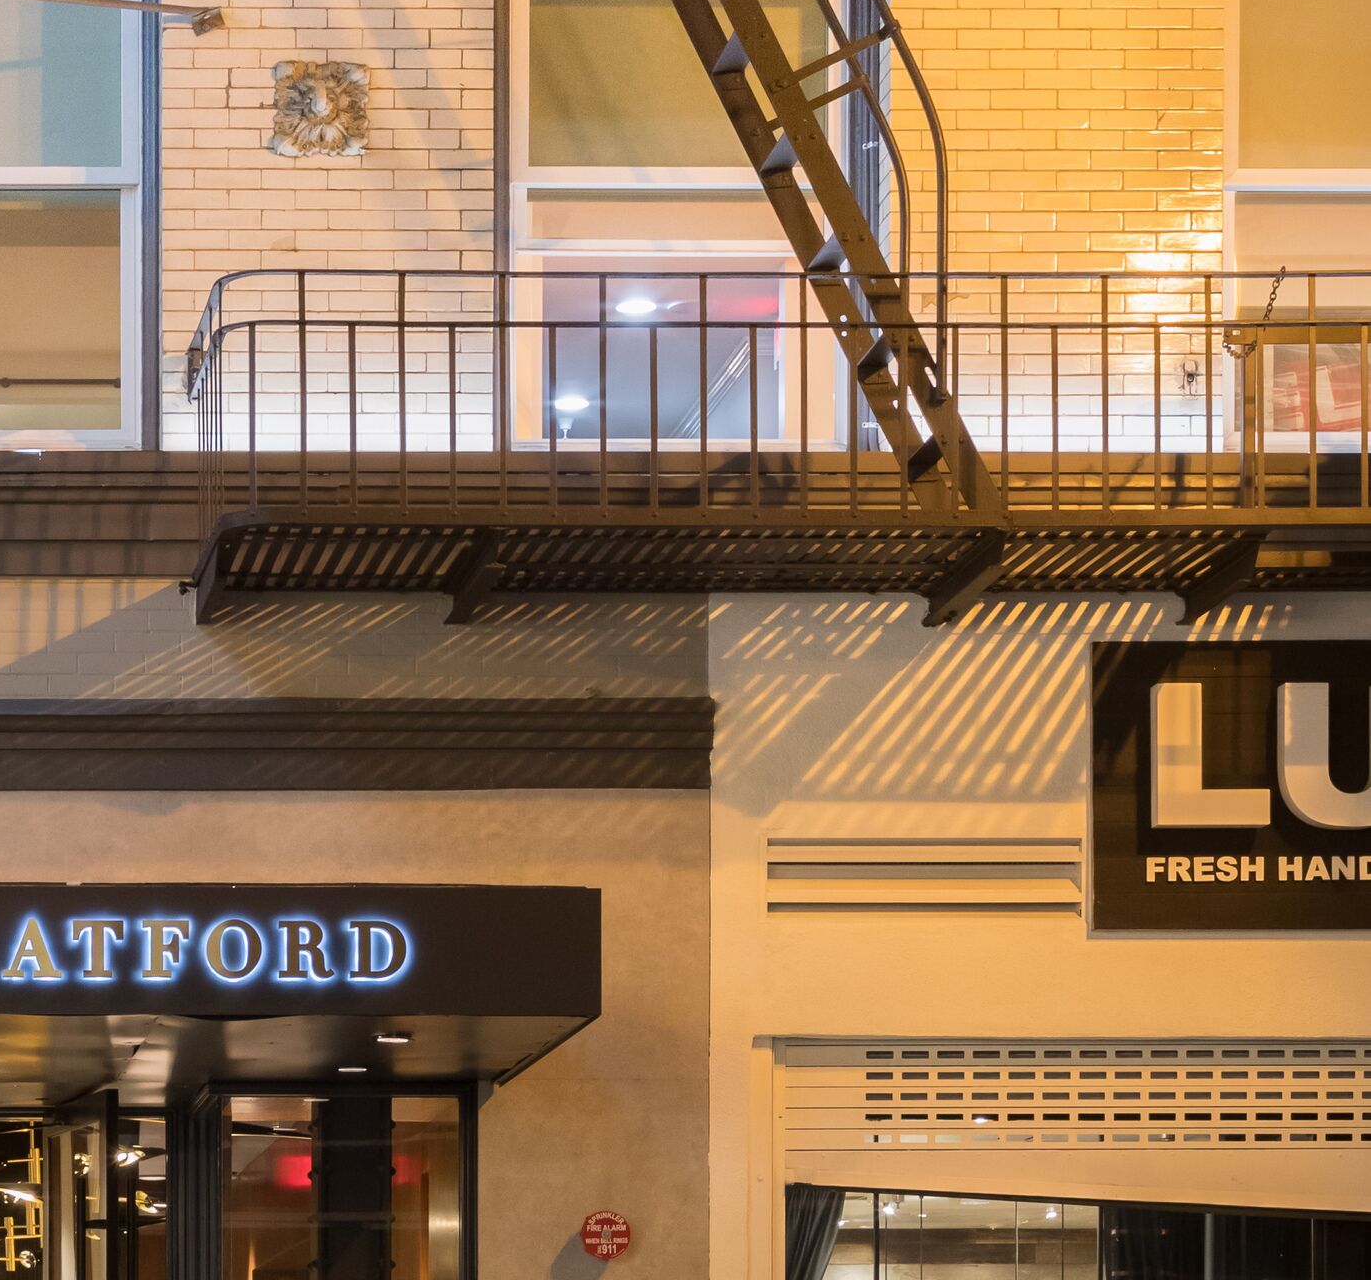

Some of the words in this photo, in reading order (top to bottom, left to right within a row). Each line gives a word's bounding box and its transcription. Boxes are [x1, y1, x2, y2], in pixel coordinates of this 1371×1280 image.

[1150, 682, 1371, 830] LU
[1146, 856, 1265, 883] FRESH
[586, 1224, 602, 1232] FIRE
[602, 1224, 627, 1232] ALARM
[601, 1244, 617, 1254] 911
